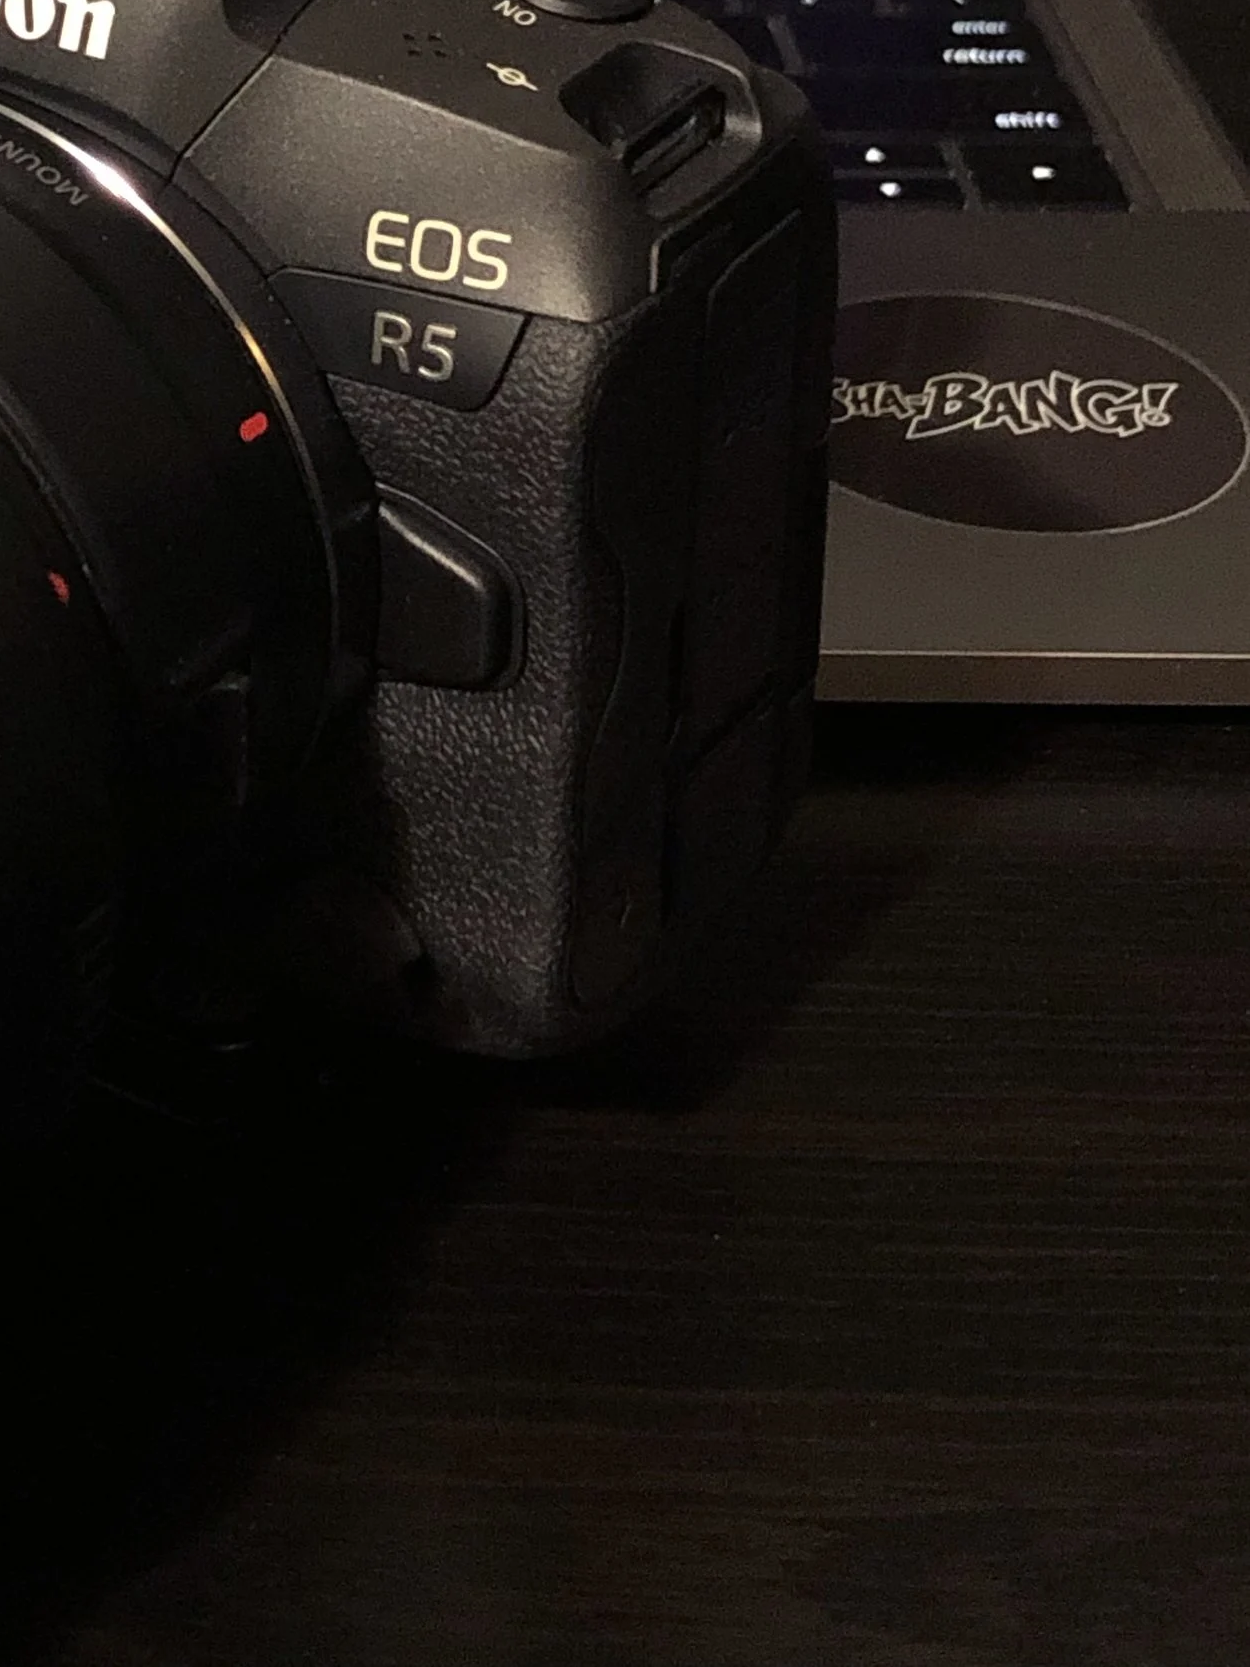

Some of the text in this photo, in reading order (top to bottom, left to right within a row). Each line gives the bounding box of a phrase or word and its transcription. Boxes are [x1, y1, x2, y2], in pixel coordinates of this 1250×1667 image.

[941, 46, 1028, 65] return
[365, 209, 513, 291] EOS
[371, 310, 458, 382] R5
